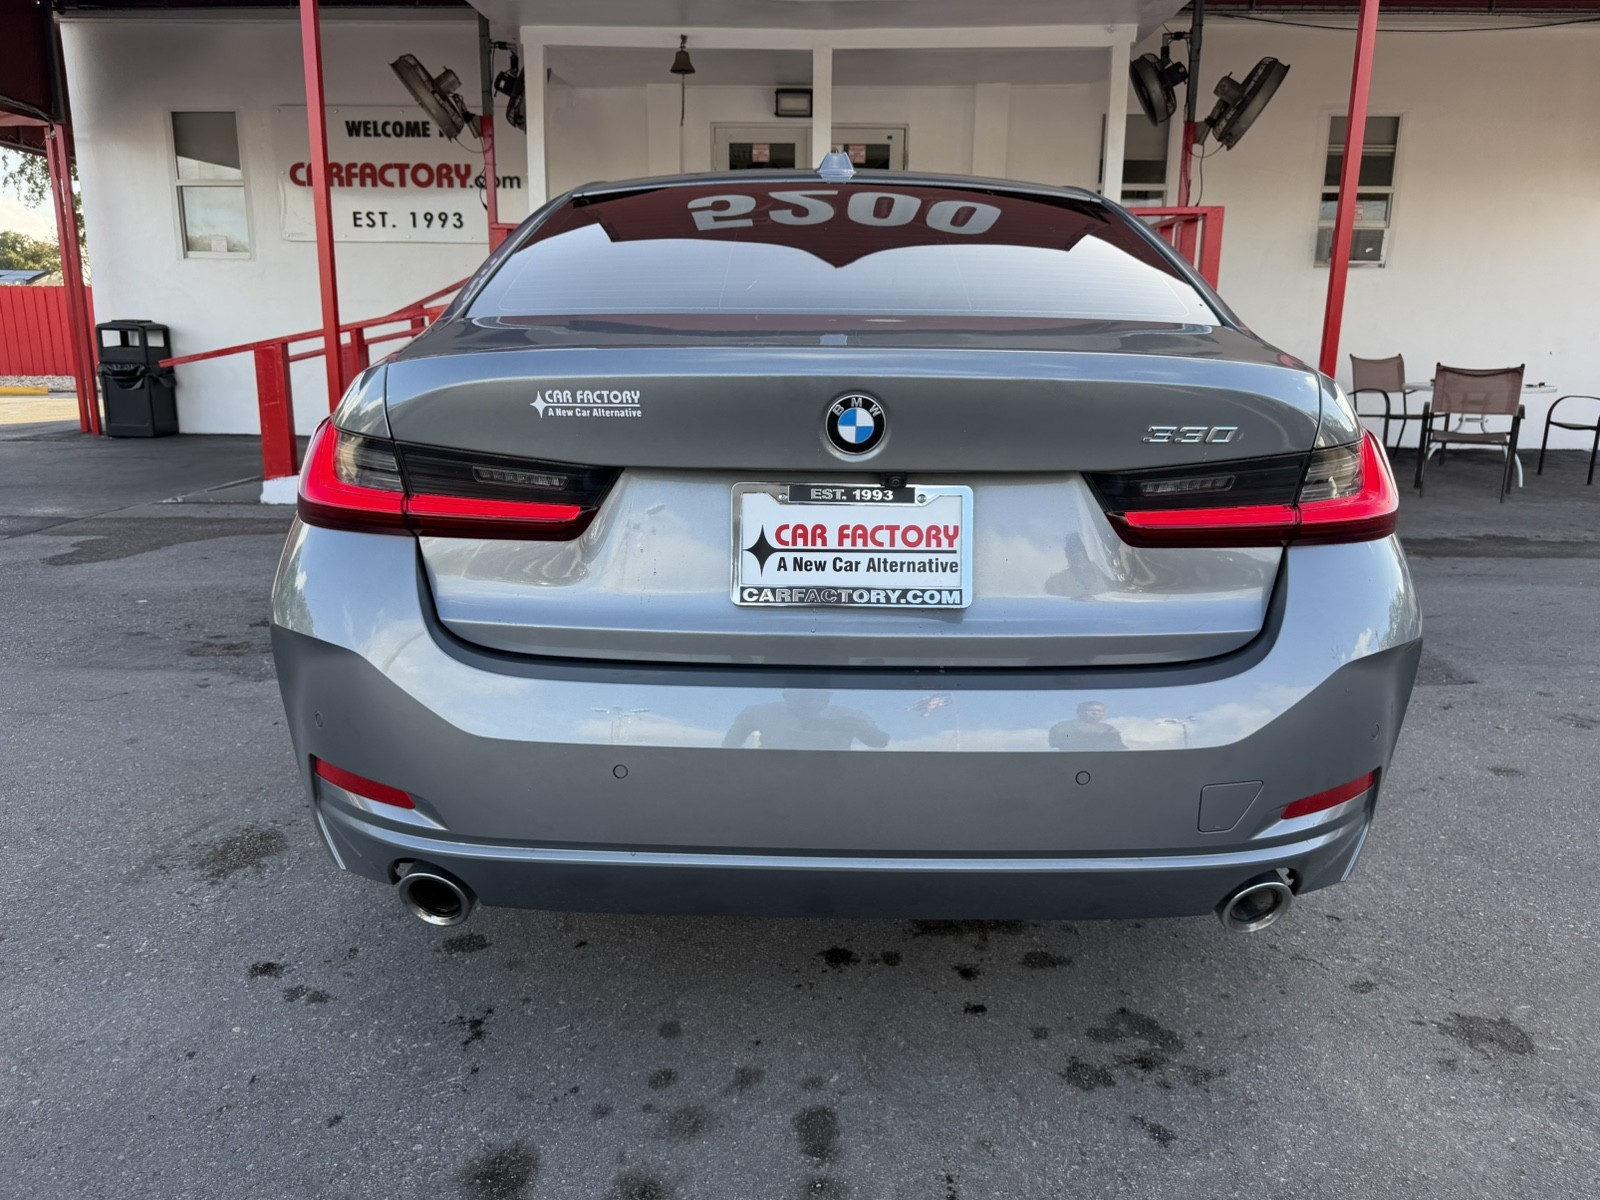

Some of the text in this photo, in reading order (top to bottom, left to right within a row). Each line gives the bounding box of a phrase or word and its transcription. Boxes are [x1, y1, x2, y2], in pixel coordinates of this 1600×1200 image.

[345, 121, 431, 138] WELCOME
[289, 161, 521, 189] CRFACTORY.cm
[353, 211, 464, 229] EST. 1993
[545, 390, 640, 404] CAR FACTORY
[548, 408, 642, 418] A New Car Alternative
[832, 397, 881, 417] BMW
[1142, 426, 1238, 443] 330
[810, 488, 894, 501] EST. 1993
[775, 523, 960, 548] CAR FACTORY
[776, 556, 959, 573] A New Car Alternative
[742, 587, 962, 605] CARFACTORY.COM
